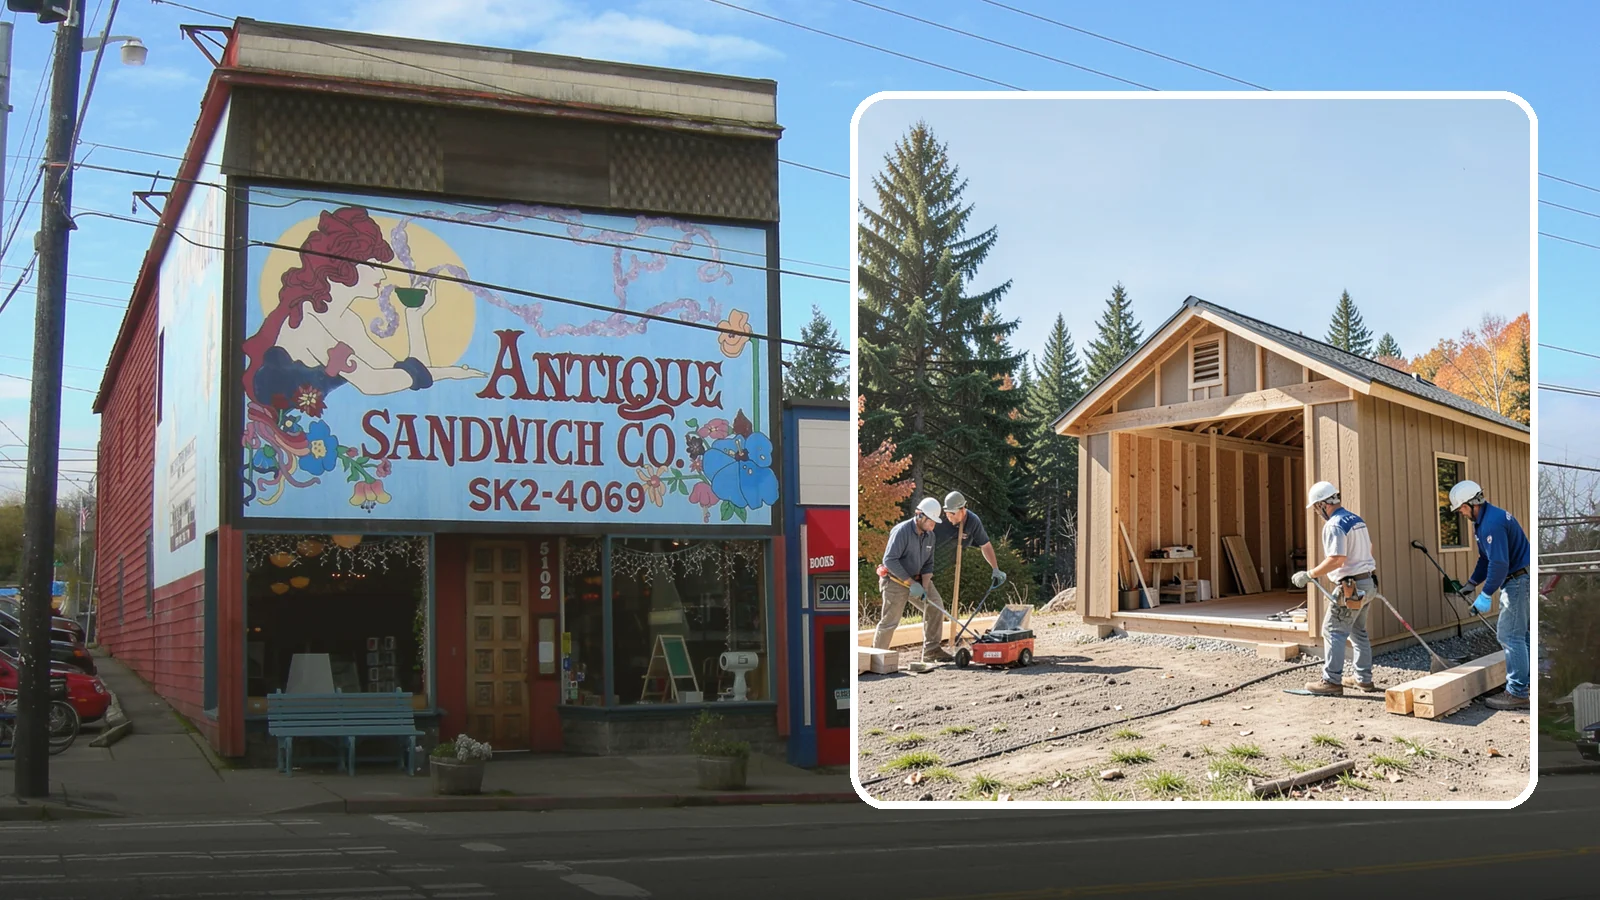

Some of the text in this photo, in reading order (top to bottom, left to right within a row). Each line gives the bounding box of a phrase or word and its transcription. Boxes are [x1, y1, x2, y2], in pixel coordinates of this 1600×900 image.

[476, 329, 724, 421] ANTIQUE
[361, 409, 684, 468] SANDWICH CO.
[468, 477, 646, 513] SK2-4069
[540, 542, 552, 599] 5102
[809, 555, 835, 569] BOOKS
